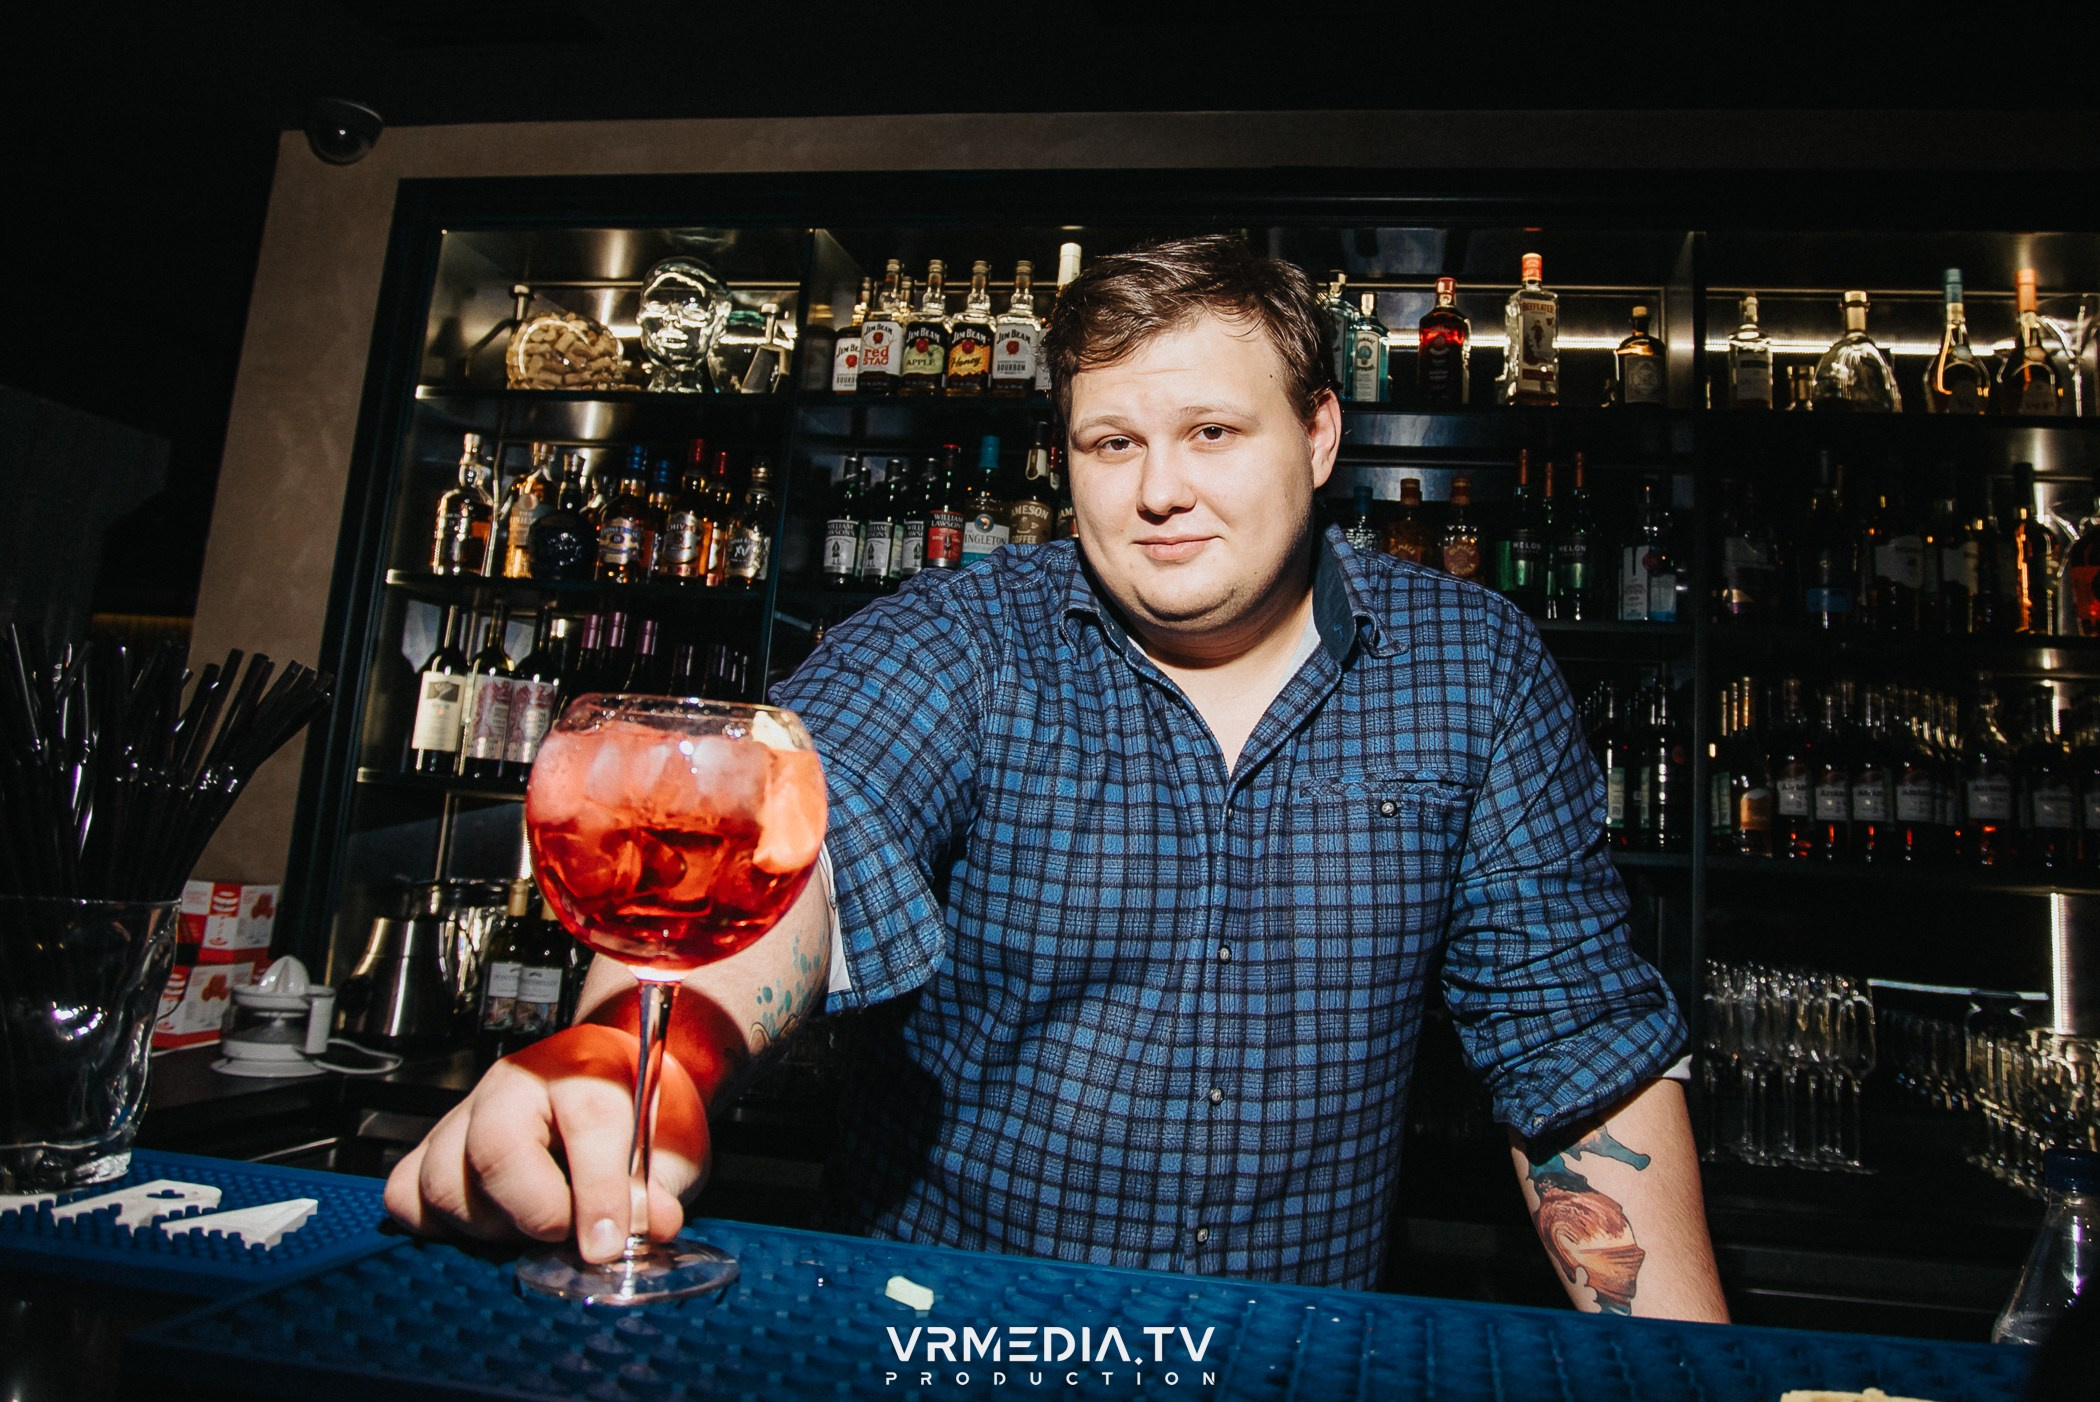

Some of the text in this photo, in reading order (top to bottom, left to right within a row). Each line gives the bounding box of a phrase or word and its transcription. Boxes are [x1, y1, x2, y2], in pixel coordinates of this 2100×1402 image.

[864, 323, 893, 335] JIM BEAM
[906, 327, 940, 343] JIM BEAM
[952, 328, 987, 344] JIM BEAM
[996, 329, 1031, 344] JIM BEAM
[836, 345, 849, 357] JIM
[864, 346, 889, 357] red
[933, 513, 964, 522] WILLIAM
